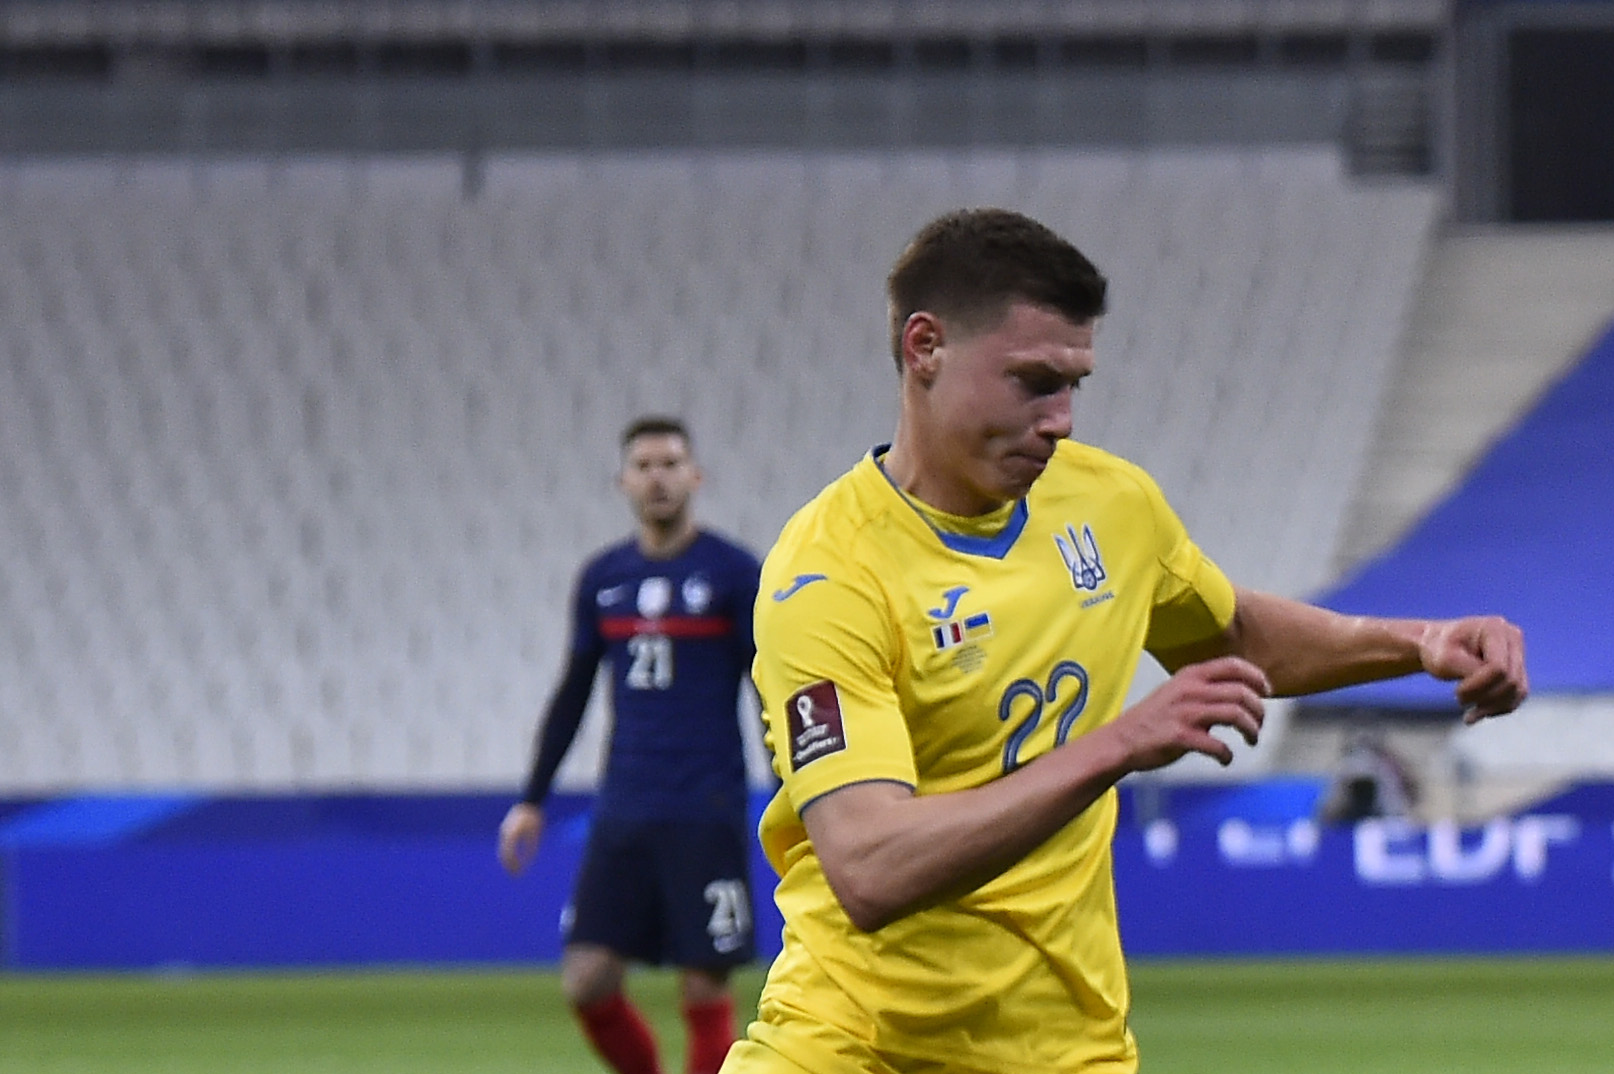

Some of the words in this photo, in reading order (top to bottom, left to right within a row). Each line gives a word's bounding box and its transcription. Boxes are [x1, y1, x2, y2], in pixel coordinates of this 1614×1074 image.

[625, 634, 675, 692] 21
[998, 659, 1089, 776] 22
[704, 878, 753, 938] 21
